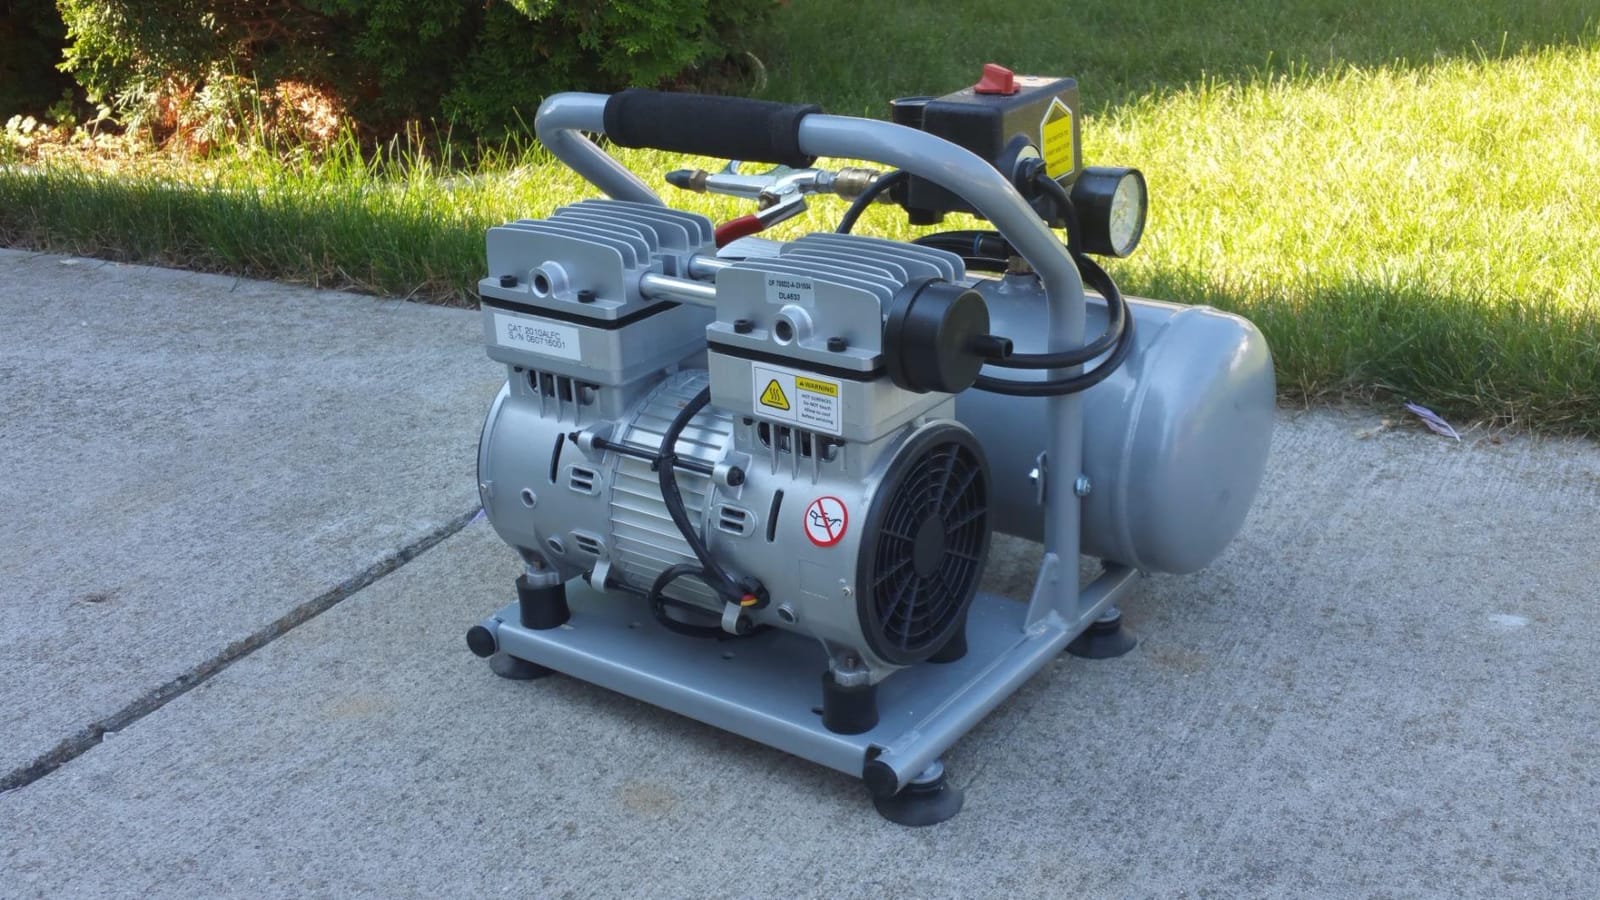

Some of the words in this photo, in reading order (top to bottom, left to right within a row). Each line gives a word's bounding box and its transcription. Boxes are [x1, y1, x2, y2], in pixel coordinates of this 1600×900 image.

[507, 323, 521, 332] CAT
[508, 331, 523, 340] S/N
[805, 382, 834, 393] WARNING
